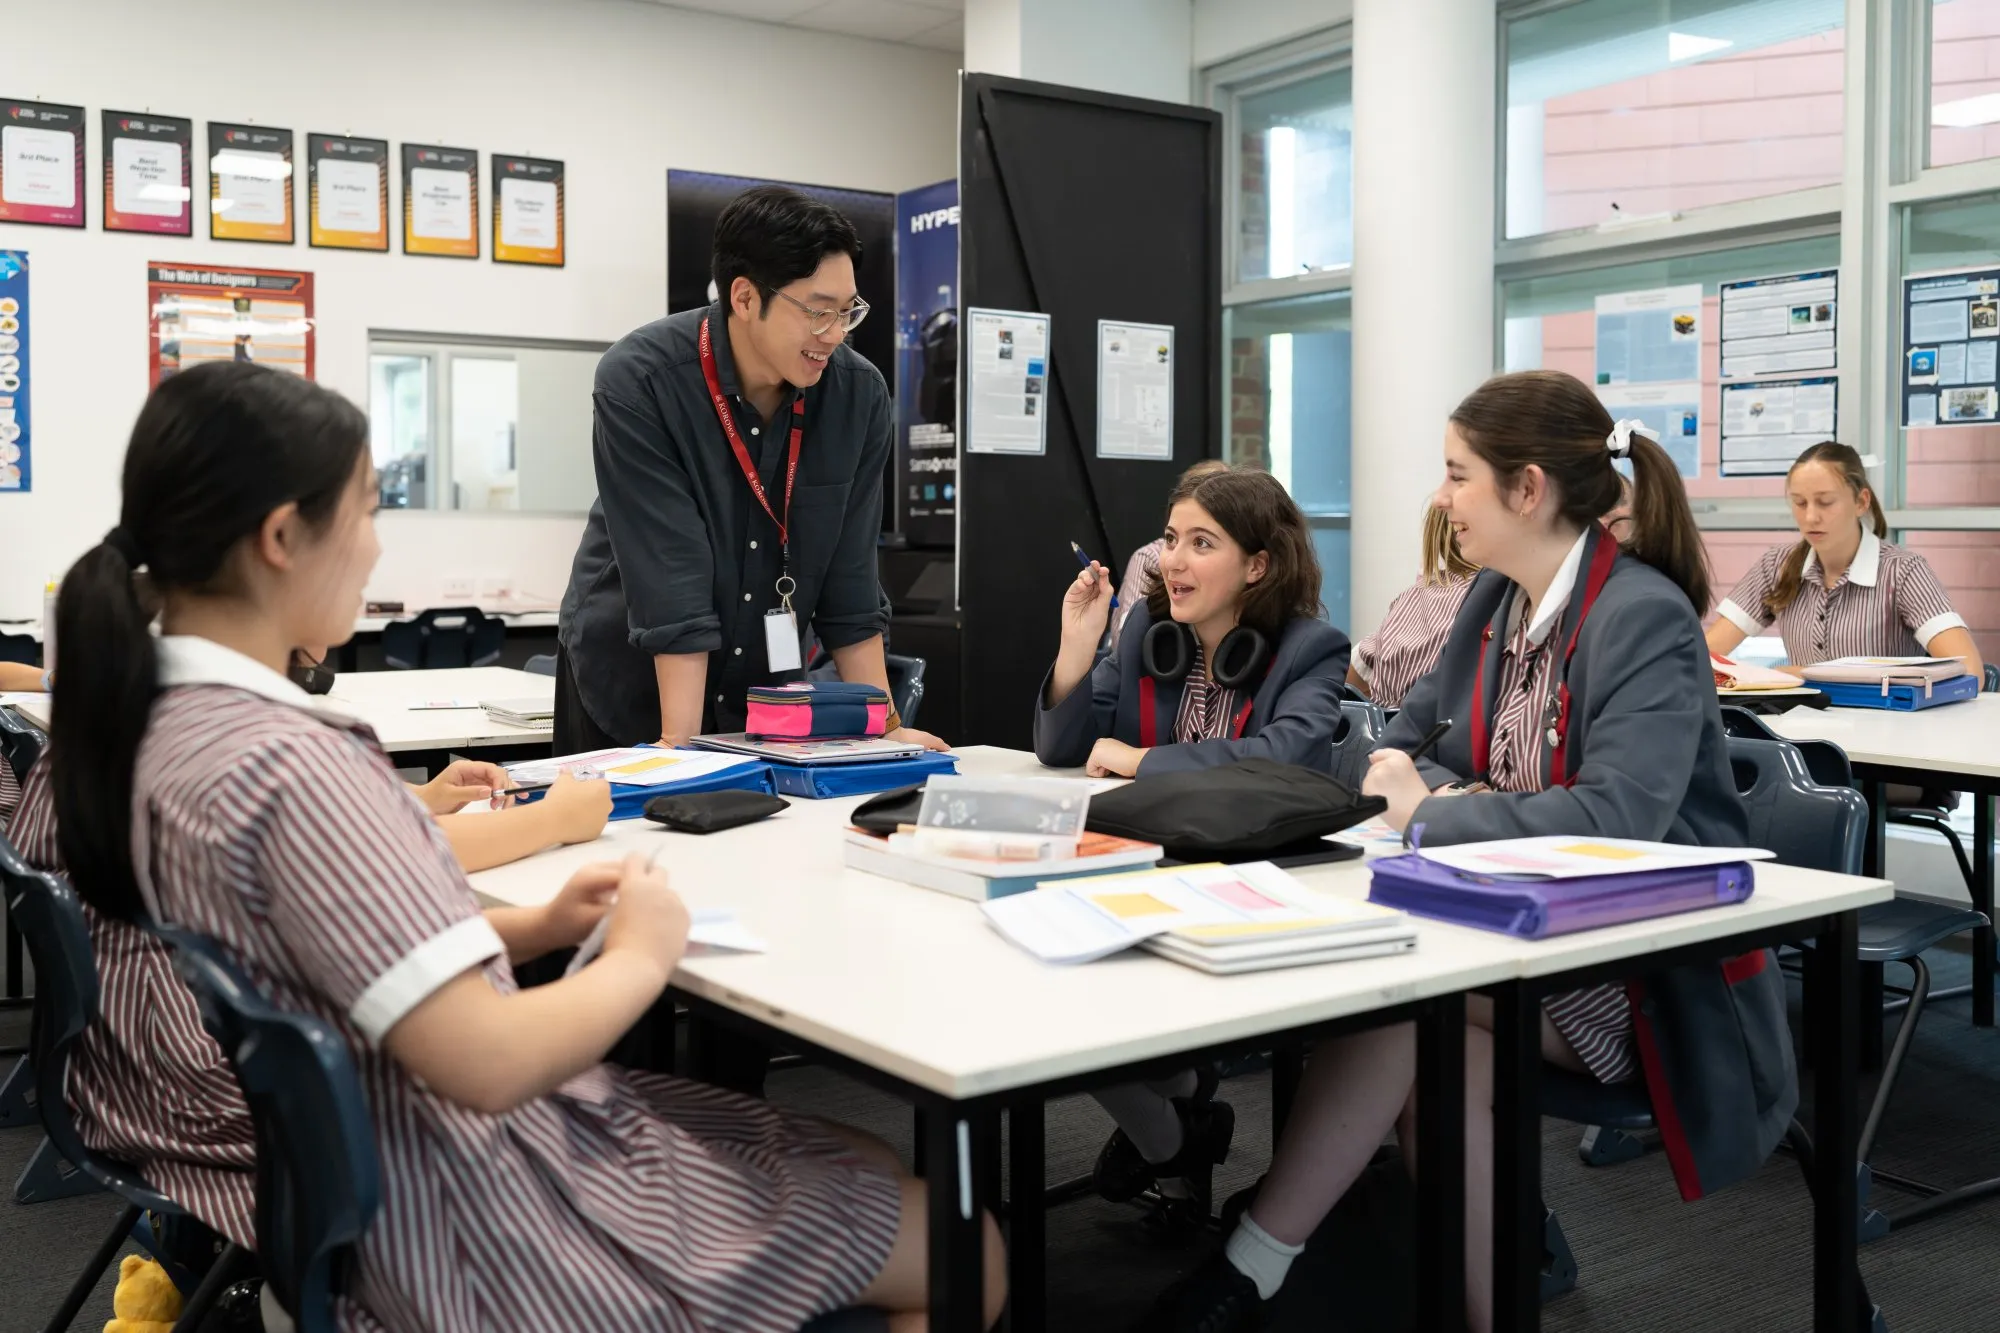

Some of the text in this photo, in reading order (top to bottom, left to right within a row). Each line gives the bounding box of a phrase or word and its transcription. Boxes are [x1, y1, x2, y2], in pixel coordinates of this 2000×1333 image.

[157, 268, 175, 282] The
[176, 270, 200, 283] Work
[201, 272, 211, 283] of
[211, 273, 257, 287] Designers
[719, 402, 735, 438] KOROWA
[787, 462, 796, 497] KOROWA
